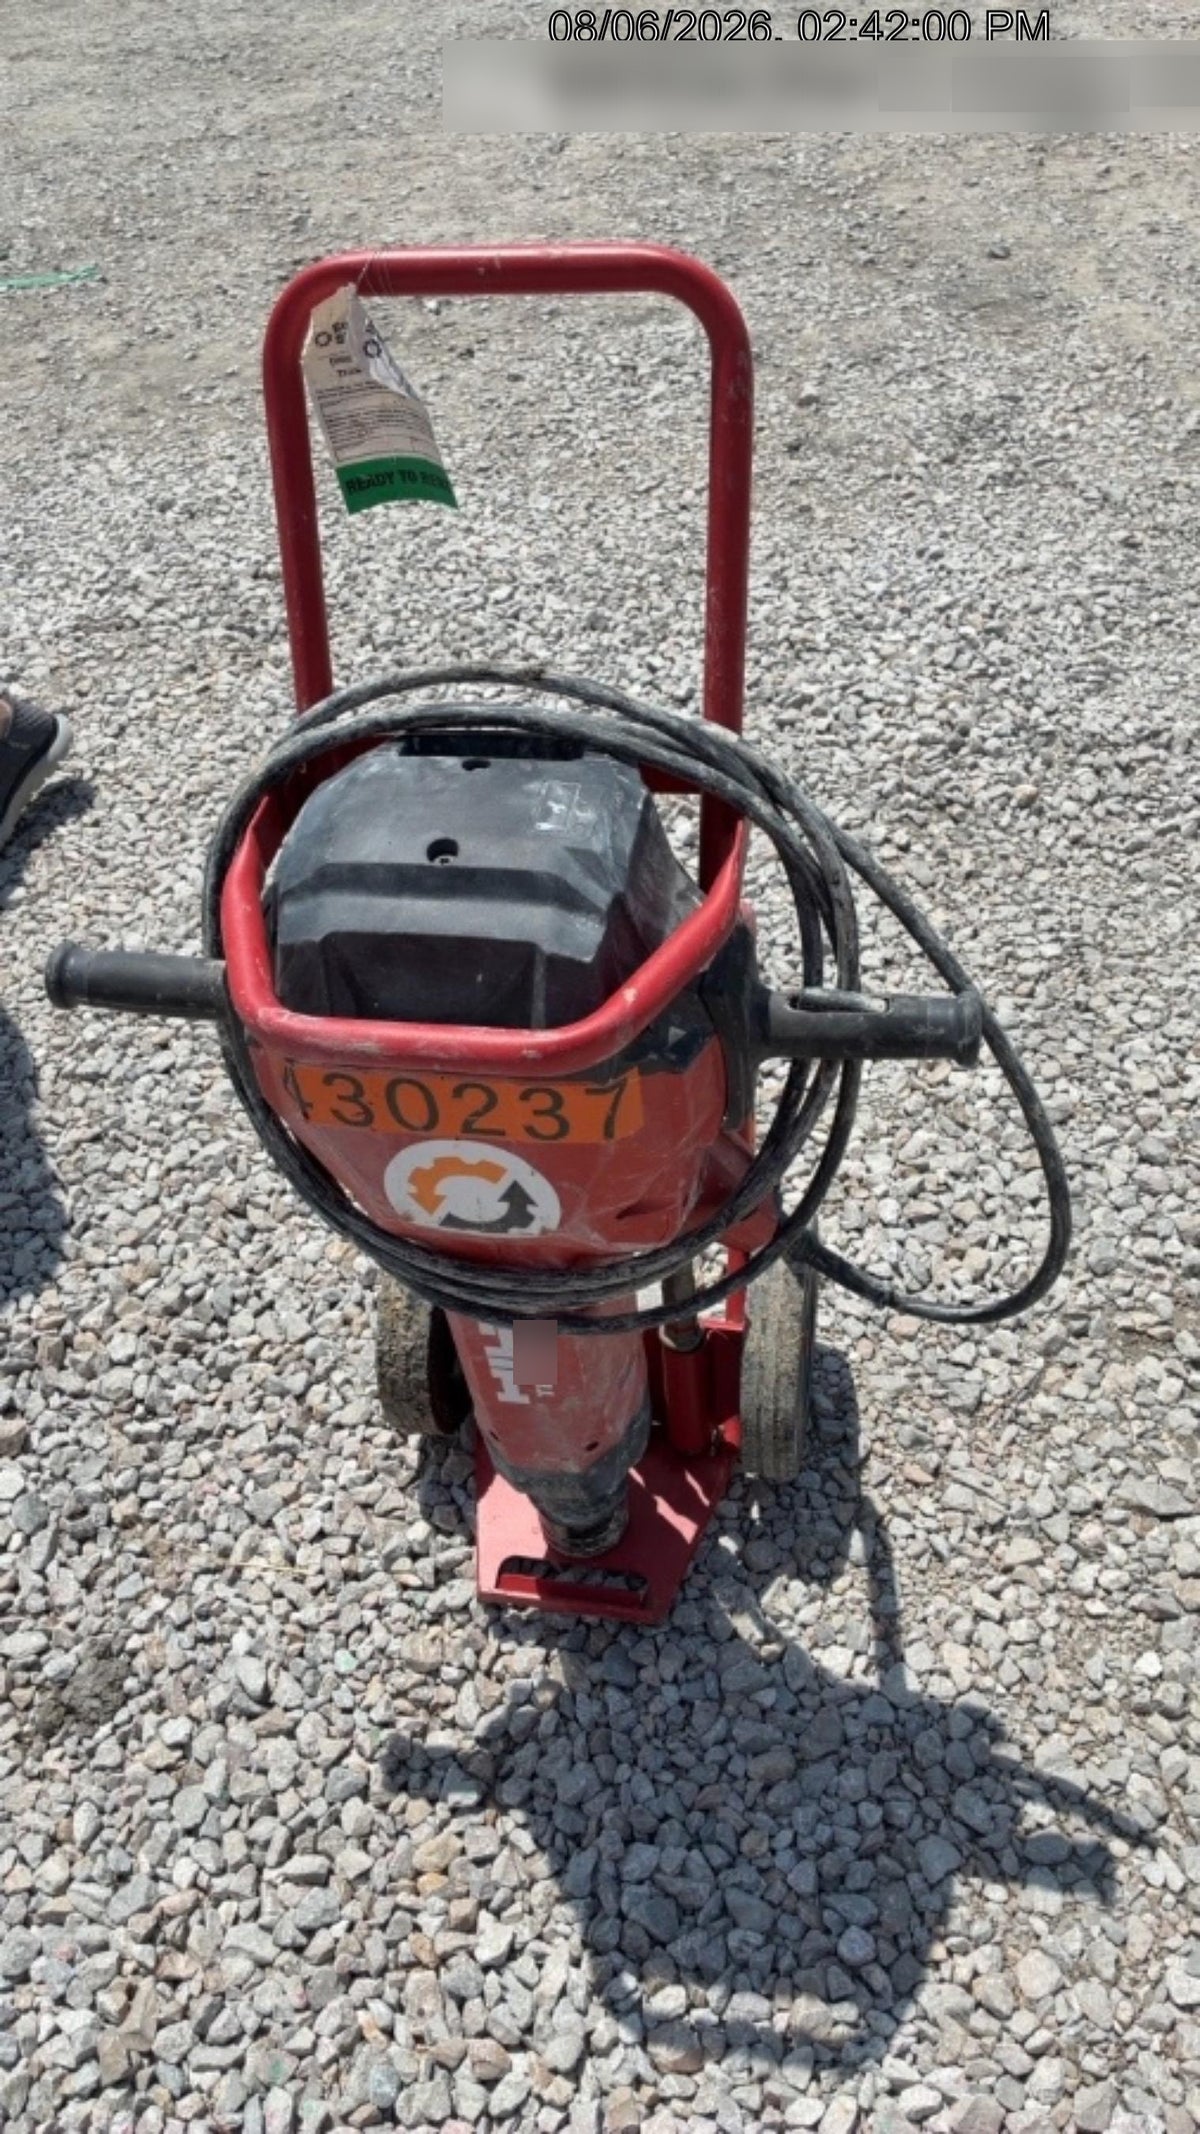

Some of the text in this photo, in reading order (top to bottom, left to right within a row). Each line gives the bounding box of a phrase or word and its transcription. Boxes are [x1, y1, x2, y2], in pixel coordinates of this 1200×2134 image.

[345, 469, 451, 496] READY TO REN
